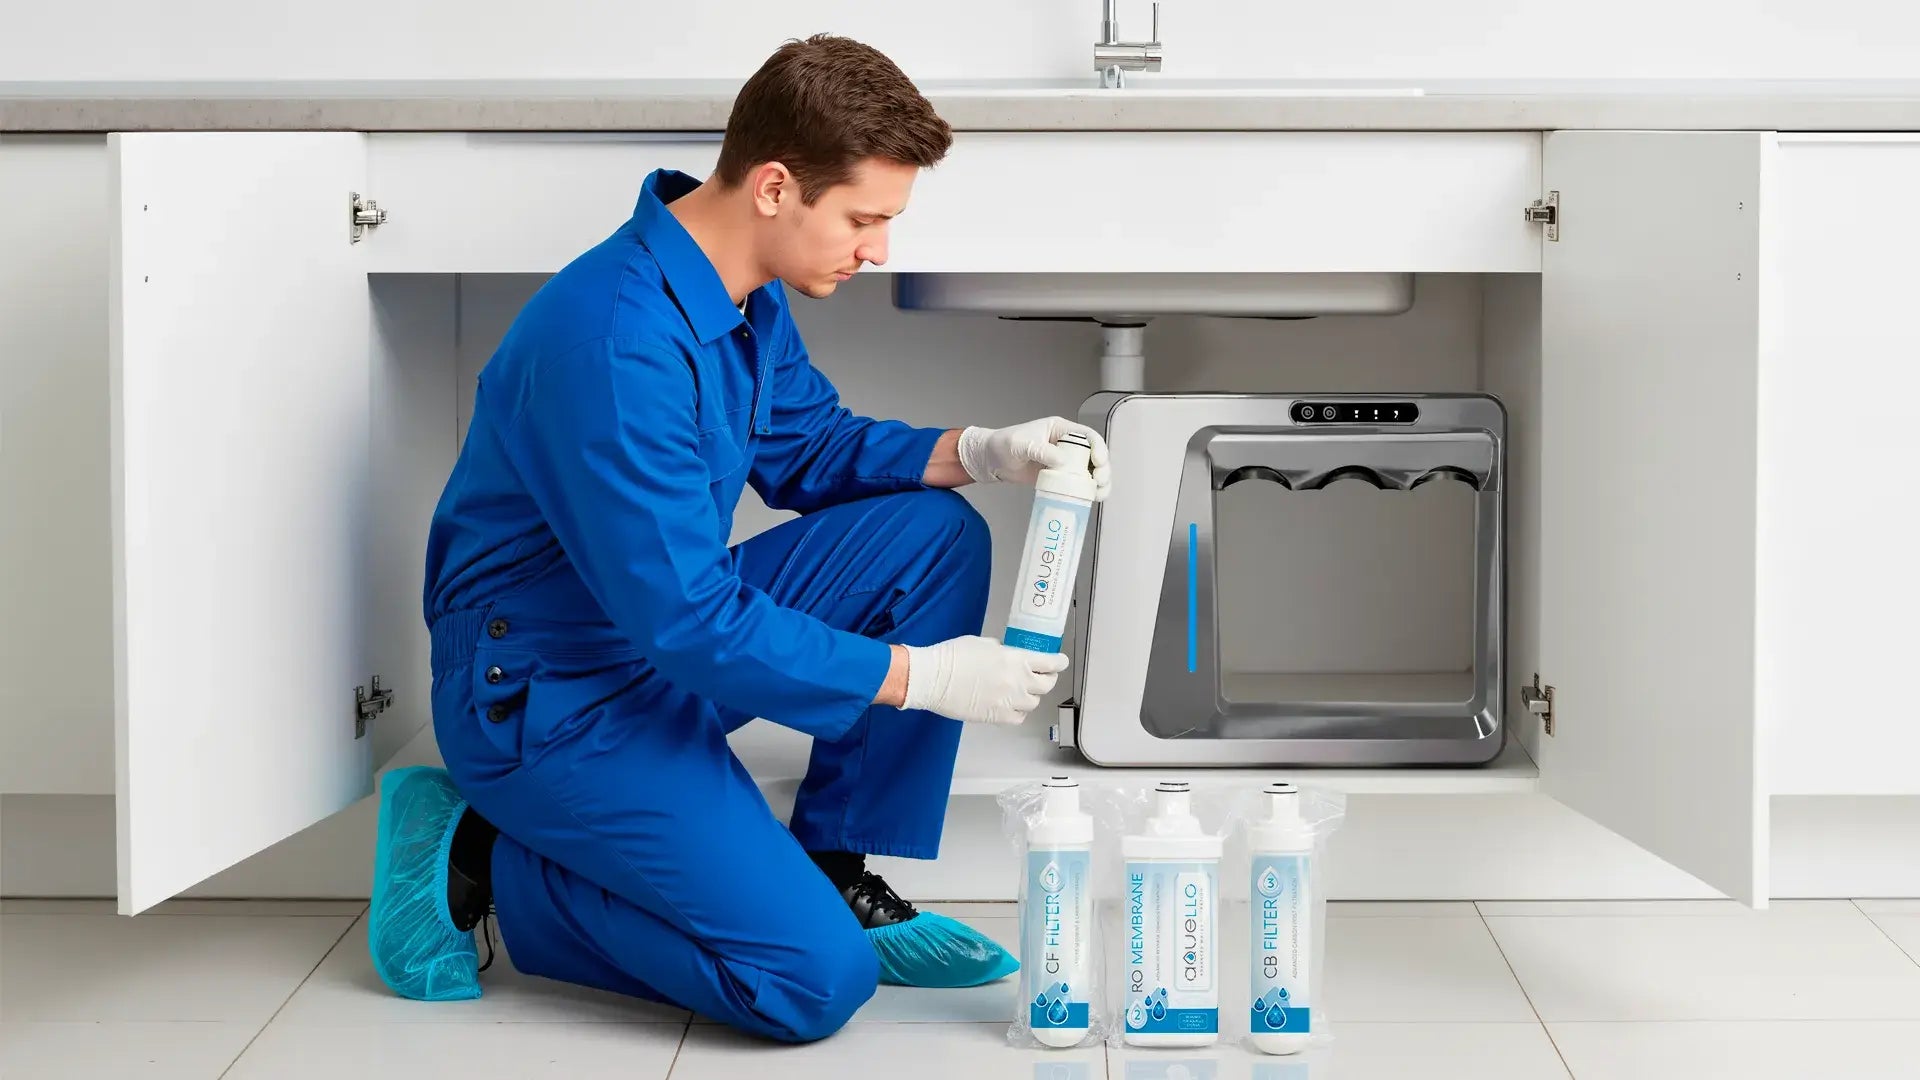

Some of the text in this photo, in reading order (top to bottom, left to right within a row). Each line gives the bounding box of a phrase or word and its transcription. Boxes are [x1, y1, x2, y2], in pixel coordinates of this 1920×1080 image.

[1267, 877, 1275, 889] 3
[1045, 894, 1060, 974] CF FILTER
[1131, 872, 1144, 993] RO MEMBRANE
[1263, 899, 1278, 979] CB FILTER
[1134, 1009, 1141, 1021] 2
